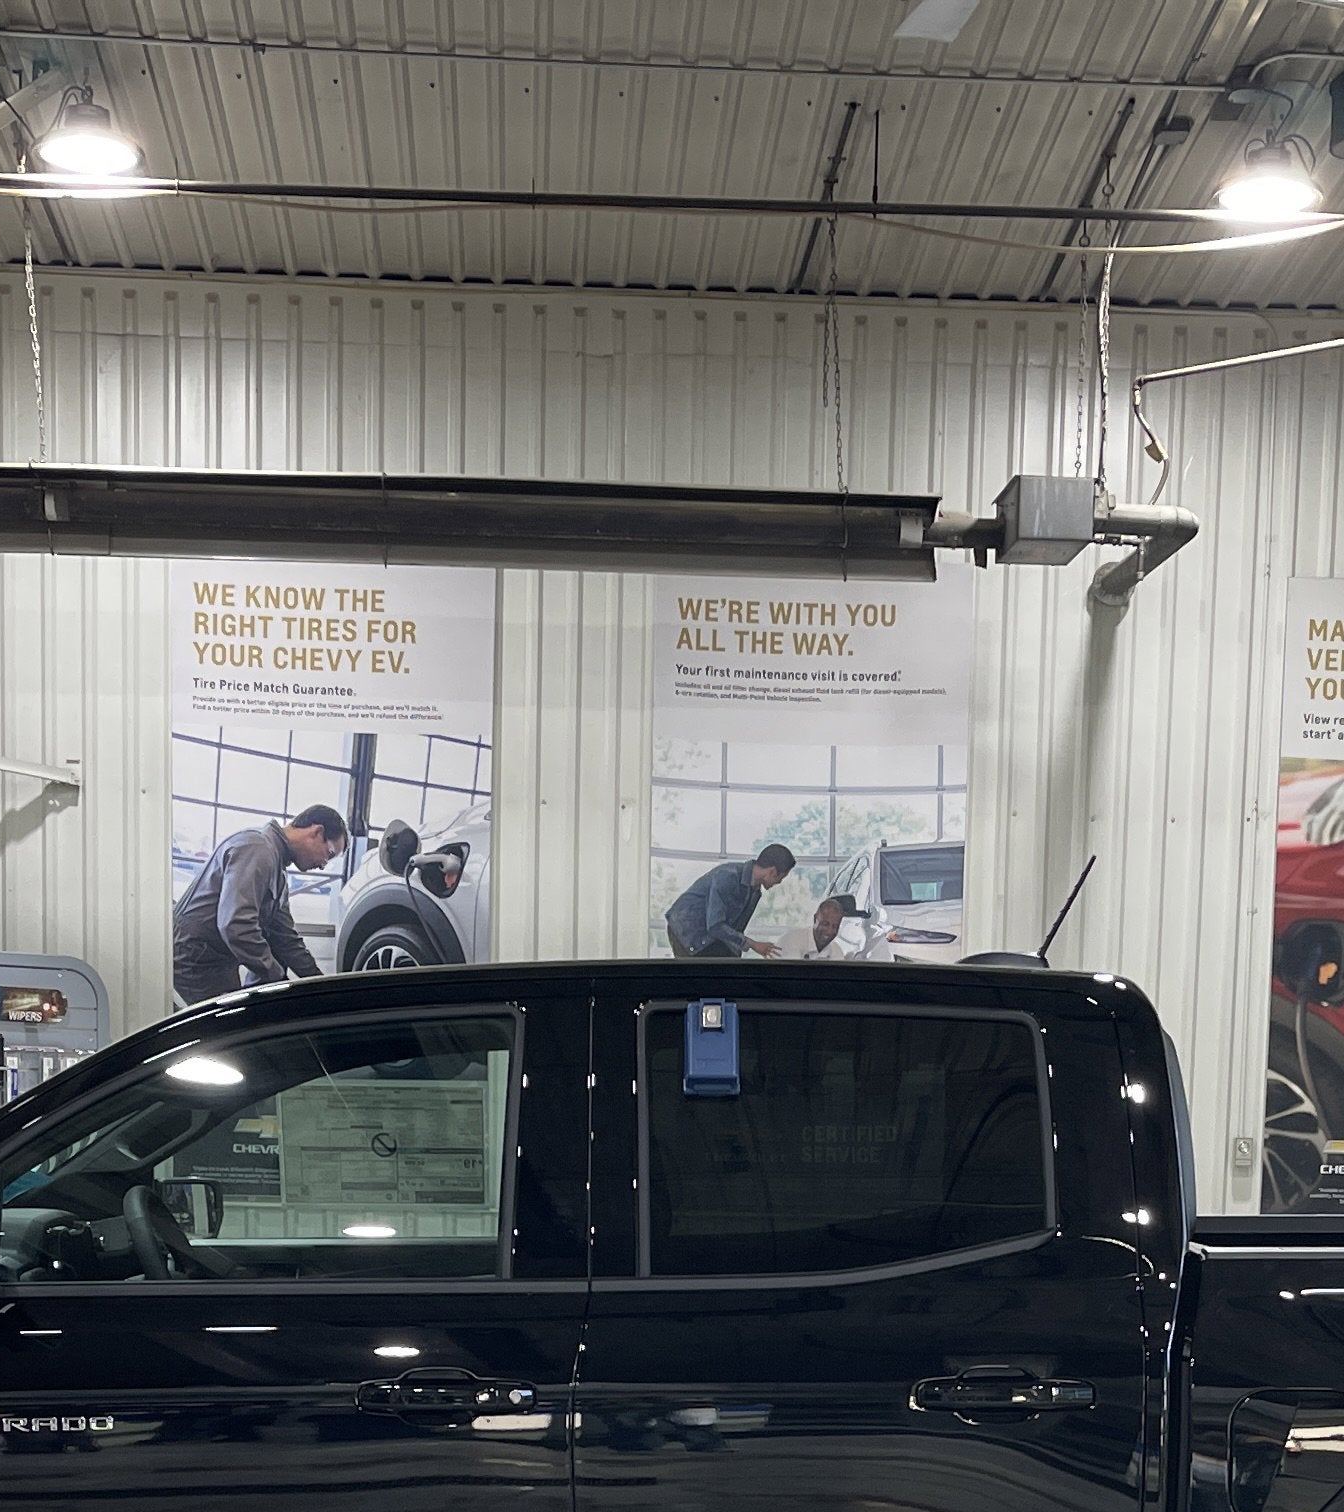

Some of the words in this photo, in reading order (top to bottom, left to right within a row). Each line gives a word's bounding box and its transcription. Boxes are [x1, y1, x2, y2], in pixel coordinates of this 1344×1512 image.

[193, 582, 235, 606] WE
[246, 585, 325, 610] KNOW
[335, 589, 385, 612] THE
[678, 597, 760, 624] WE'RE
[769, 601, 836, 626] WITH
[846, 603, 896, 627] YOU
[194, 613, 273, 638] RIGHT
[282, 617, 357, 642] TIRES
[367, 620, 416, 644] FOR
[676, 627, 726, 652] ALL
[734, 630, 784, 655] THE
[792, 632, 854, 656] WAY.
[193, 642, 263, 668] YOUR
[273, 647, 362, 672] CHEVY
[372, 650, 410, 674] EV.
[675, 664, 702, 676] Your
[705, 665, 731, 678] first
[734, 666, 808, 681] maintenance
[811, 669, 836, 681] visit
[838, 670, 849, 681] is
[193, 678, 215, 690] Tire
[220, 680, 250, 692] Price
[254, 681, 289, 694] Match
[292, 684, 357, 697] Guarantee.
[1303, 713, 1330, 725] View
[8, 1010, 43, 1022] WIPERS
[232, 1143, 280, 1154] CHEVR
